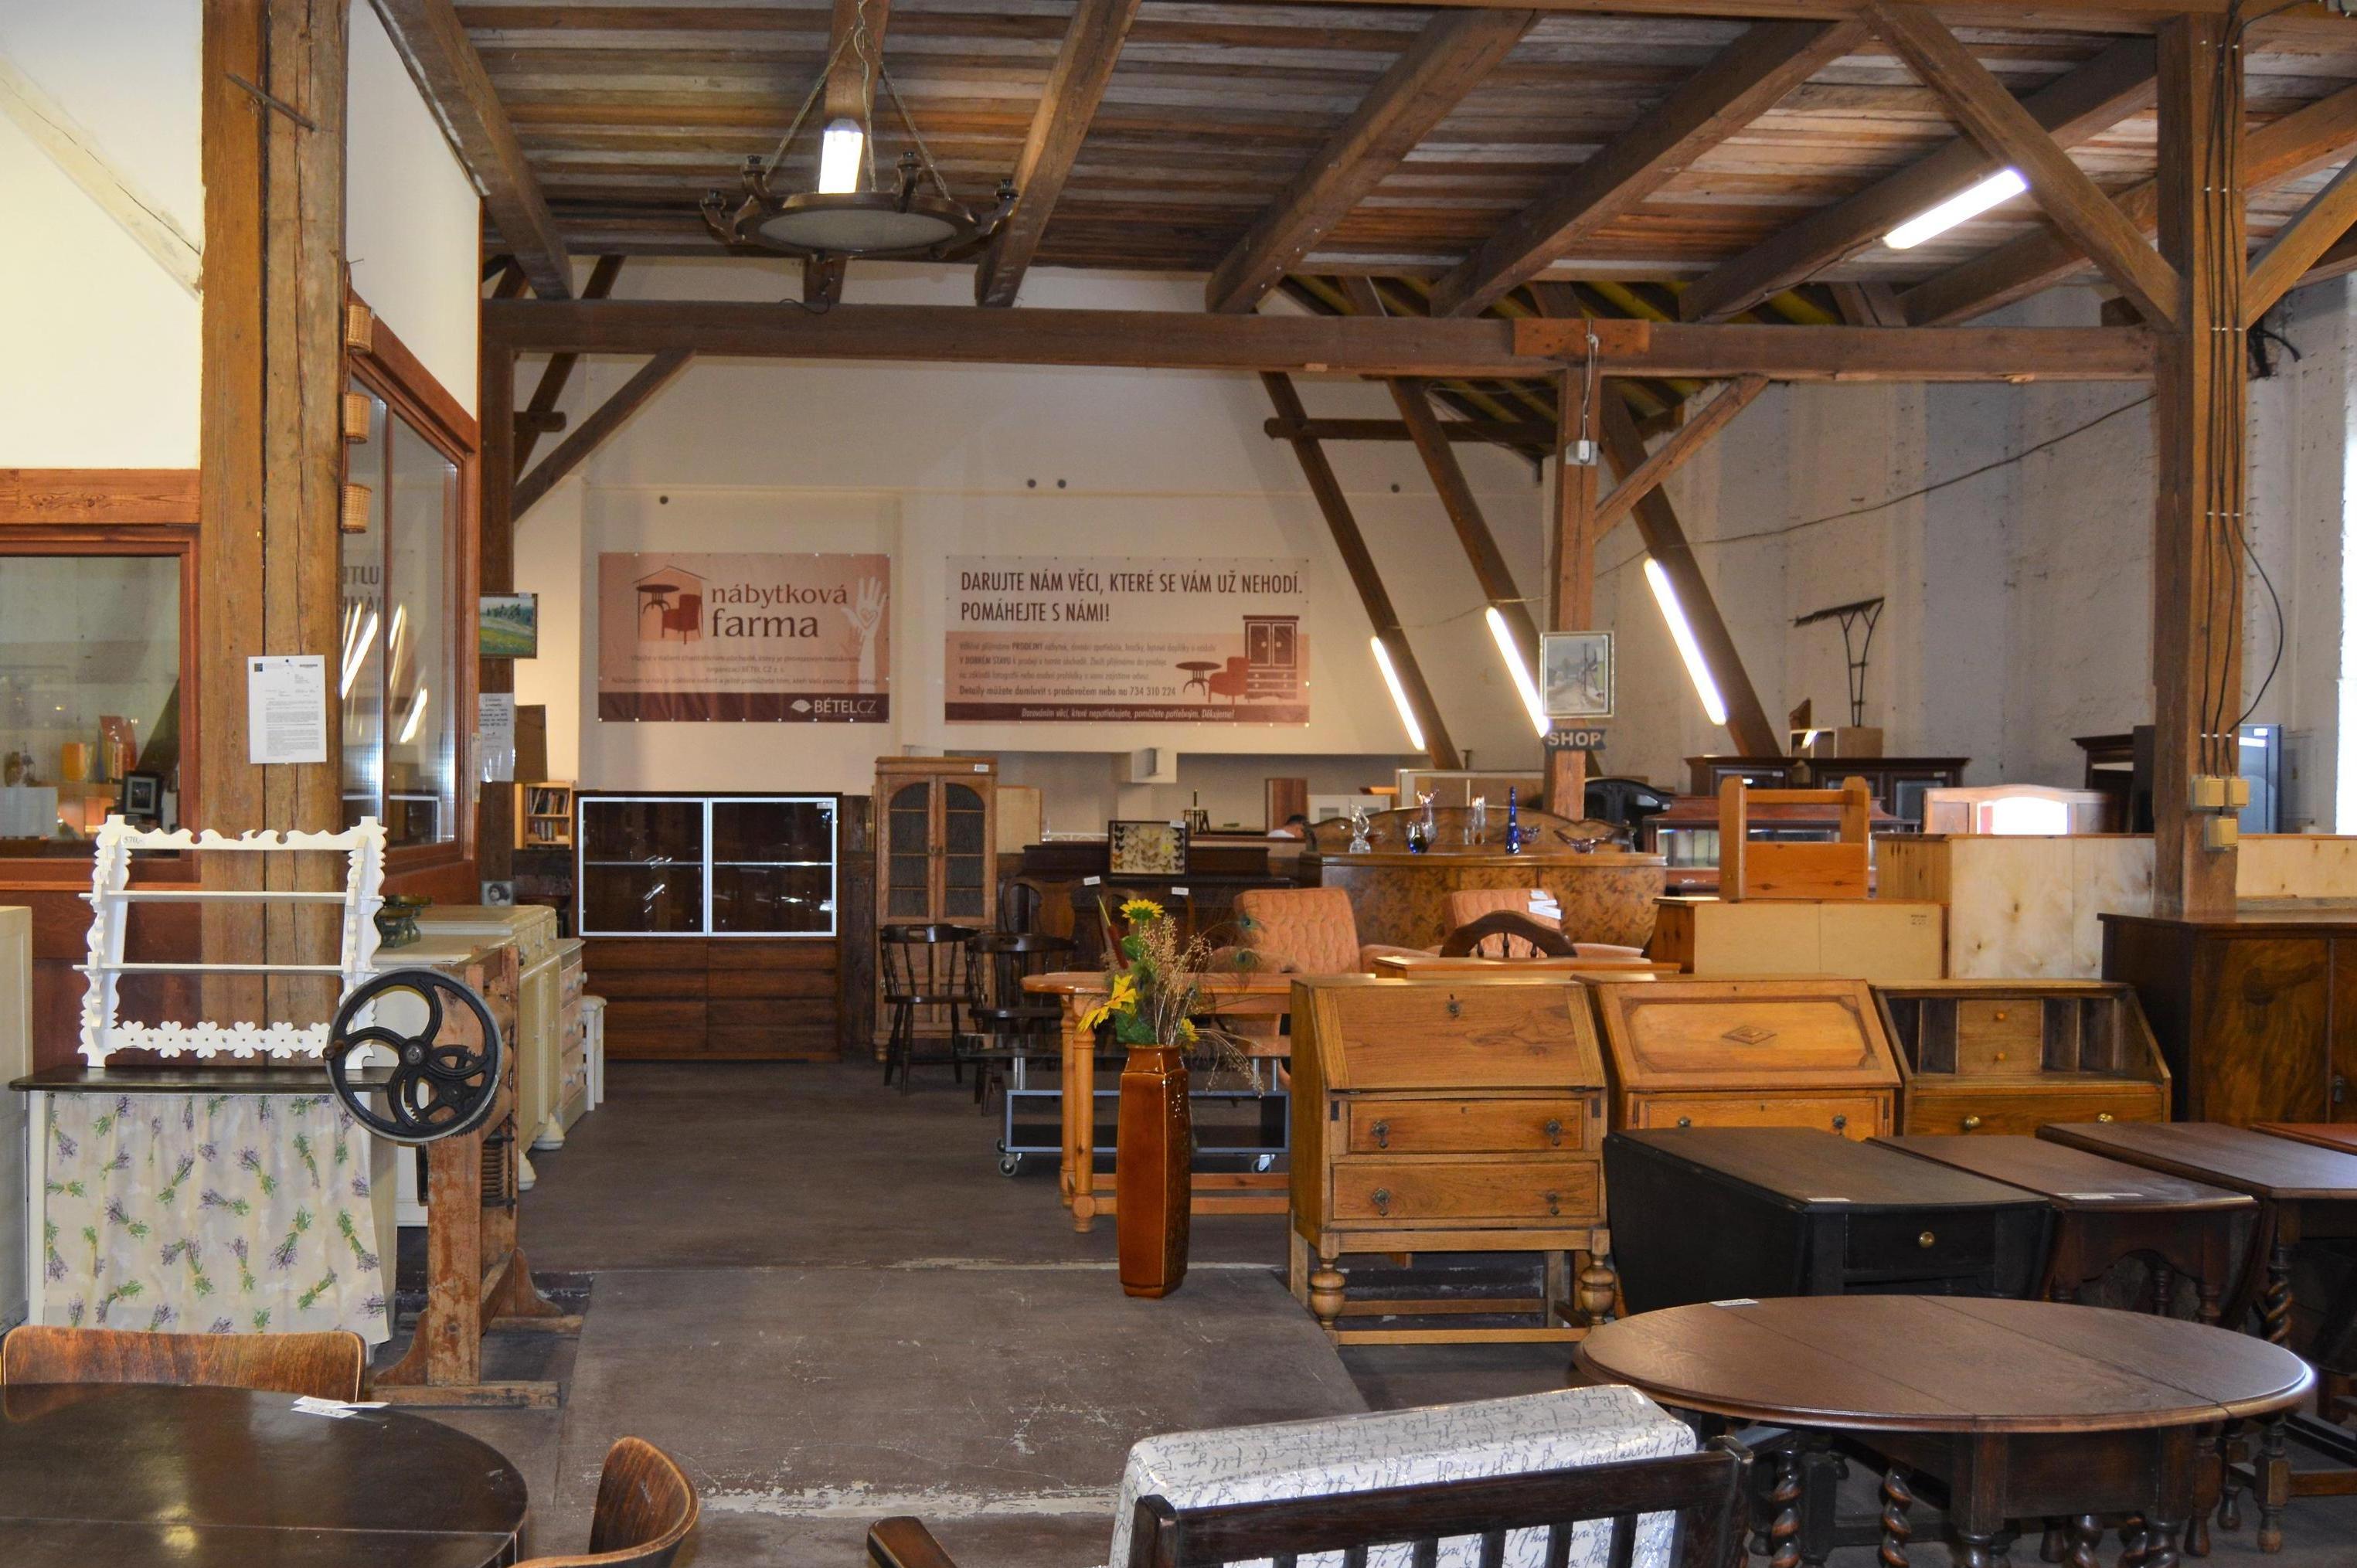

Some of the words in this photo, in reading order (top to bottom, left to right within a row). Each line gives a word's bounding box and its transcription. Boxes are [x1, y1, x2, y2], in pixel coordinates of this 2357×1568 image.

[961, 572, 1025, 591] DARUJTE
[1030, 569, 1063, 591] NÁM
[1068, 568, 1104, 595] VĚCI,
[1110, 570, 1154, 593] KTERÉ
[1160, 573, 1176, 593] SE
[1181, 570, 1212, 593] VÁM
[1218, 570, 1236, 594] UŽ
[1242, 570, 1303, 594] NEHODÍ.
[711, 583, 847, 609] nábytková
[961, 598, 1046, 621] POMÁHEJTE
[1052, 603, 1060, 621] S
[1066, 599, 1110, 622] NÁMI!
[711, 608, 819, 638] farma
[1130, 686, 1144, 696] 734
[1147, 686, 1160, 696] 310
[1548, 731, 1601, 747] SHOP
